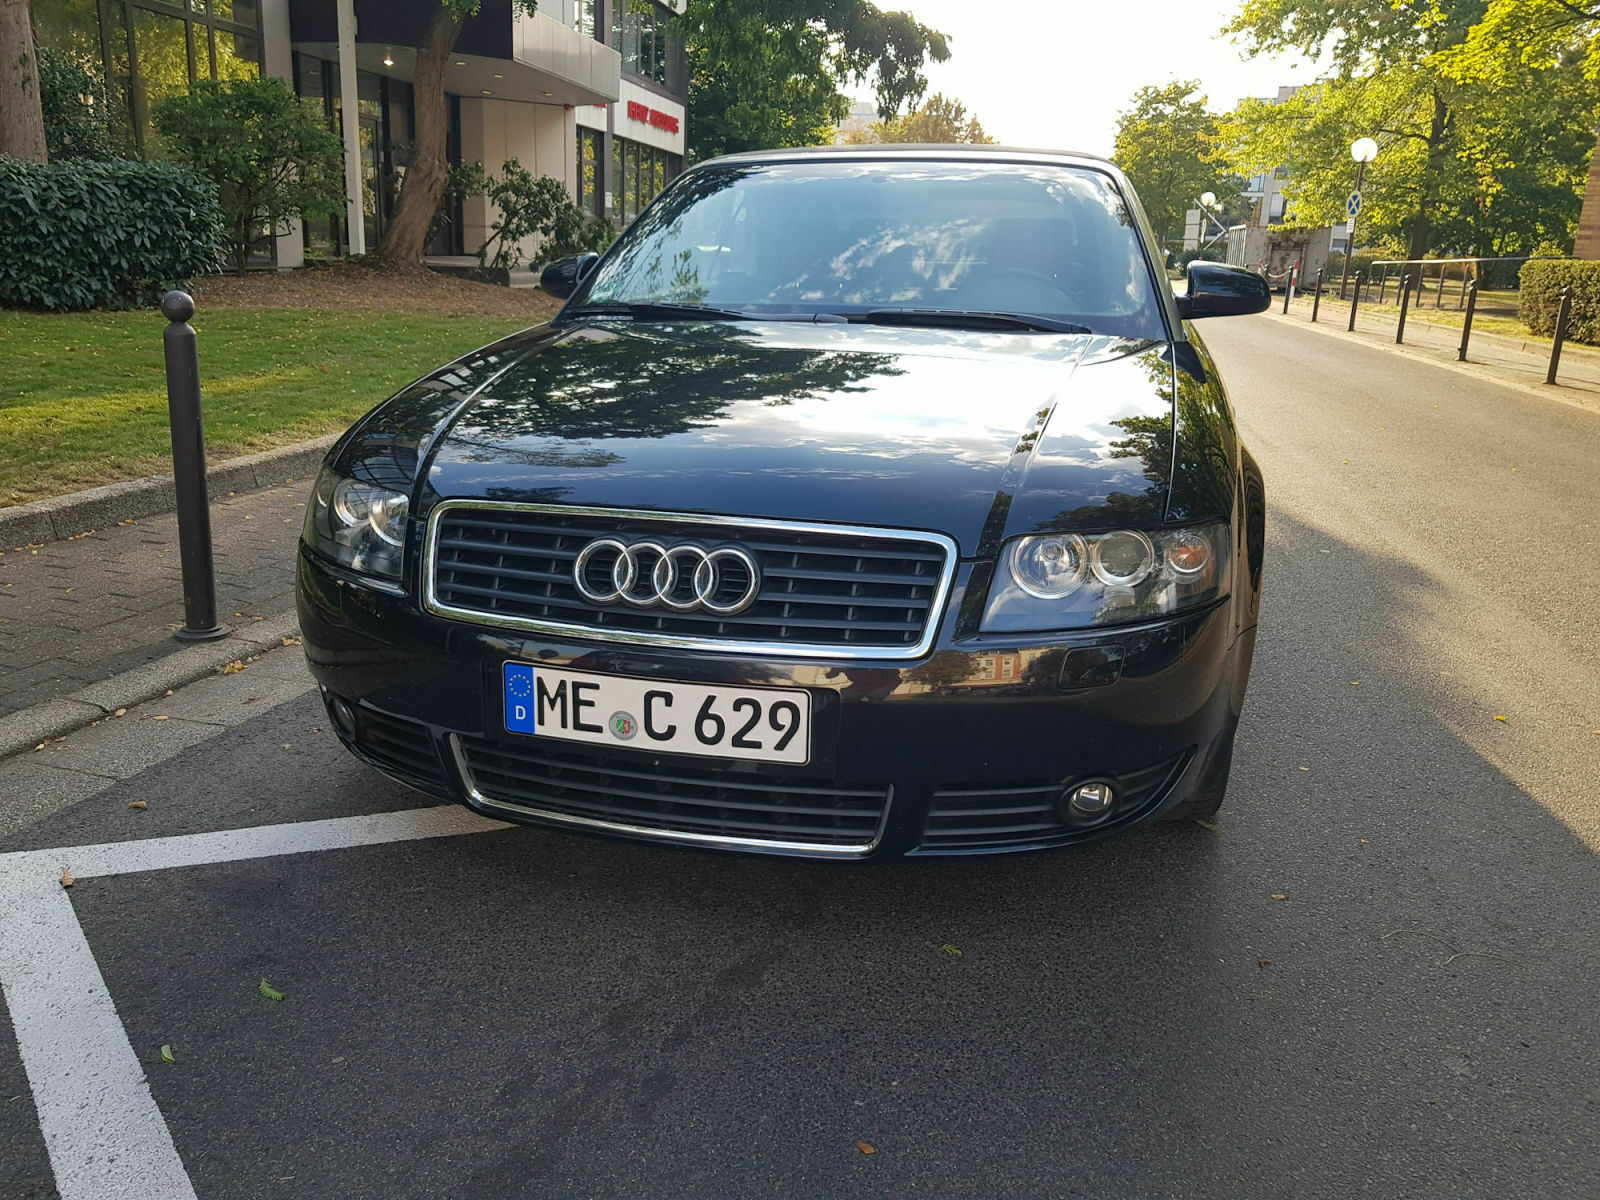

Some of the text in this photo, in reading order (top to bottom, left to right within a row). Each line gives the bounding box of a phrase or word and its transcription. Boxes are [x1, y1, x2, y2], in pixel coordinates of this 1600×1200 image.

[515, 705, 526, 720] D
[536, 676, 604, 734] ME
[643, 690, 677, 742] C
[694, 695, 801, 751] 629
